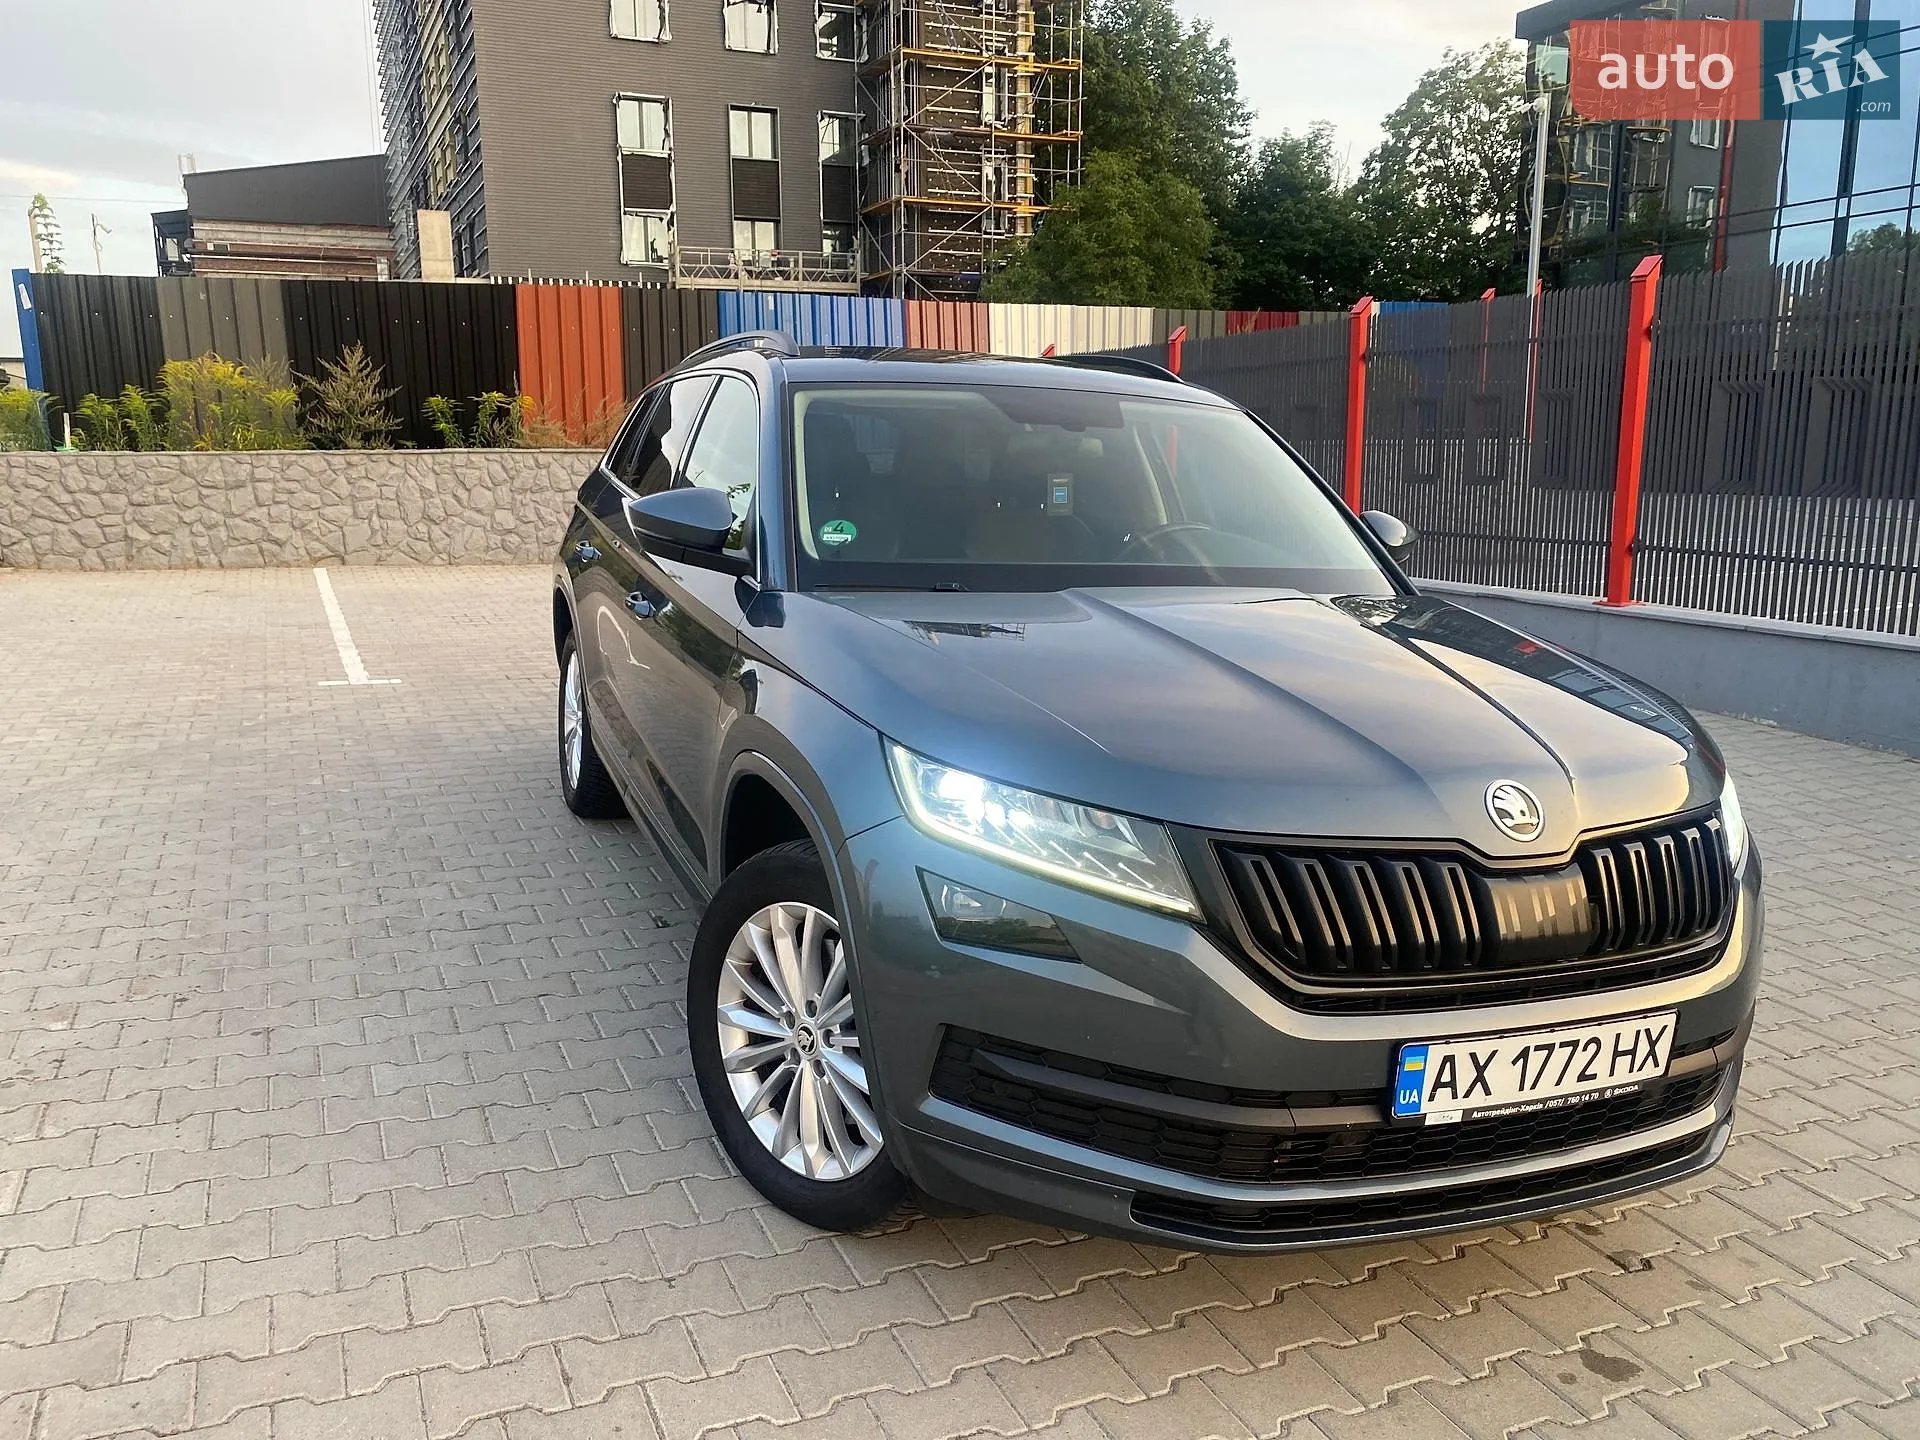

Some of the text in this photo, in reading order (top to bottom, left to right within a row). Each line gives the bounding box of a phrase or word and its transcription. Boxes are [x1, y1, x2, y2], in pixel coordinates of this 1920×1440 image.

[833, 521, 845, 534] 4
[1427, 1024, 1669, 1102] AX 1772 HX
[1399, 1089, 1419, 1105] UA
